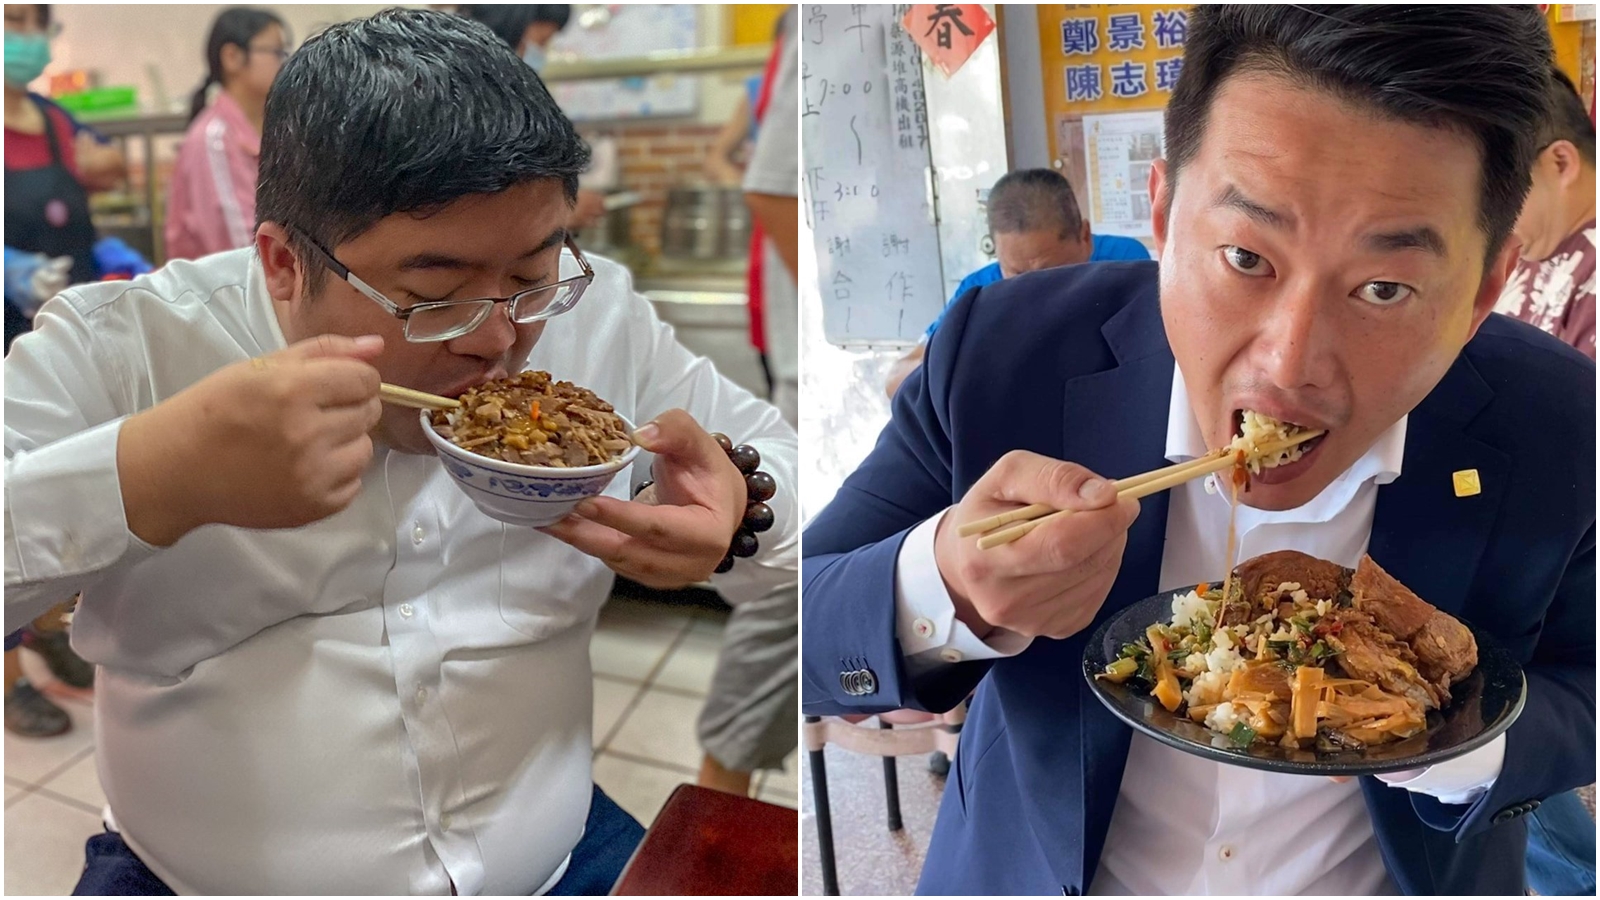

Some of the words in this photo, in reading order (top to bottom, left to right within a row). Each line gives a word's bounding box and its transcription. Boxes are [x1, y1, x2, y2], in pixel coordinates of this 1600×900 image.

[923, 4, 975, 50] 春
[1061, 9, 1188, 55] 鄭景裕
